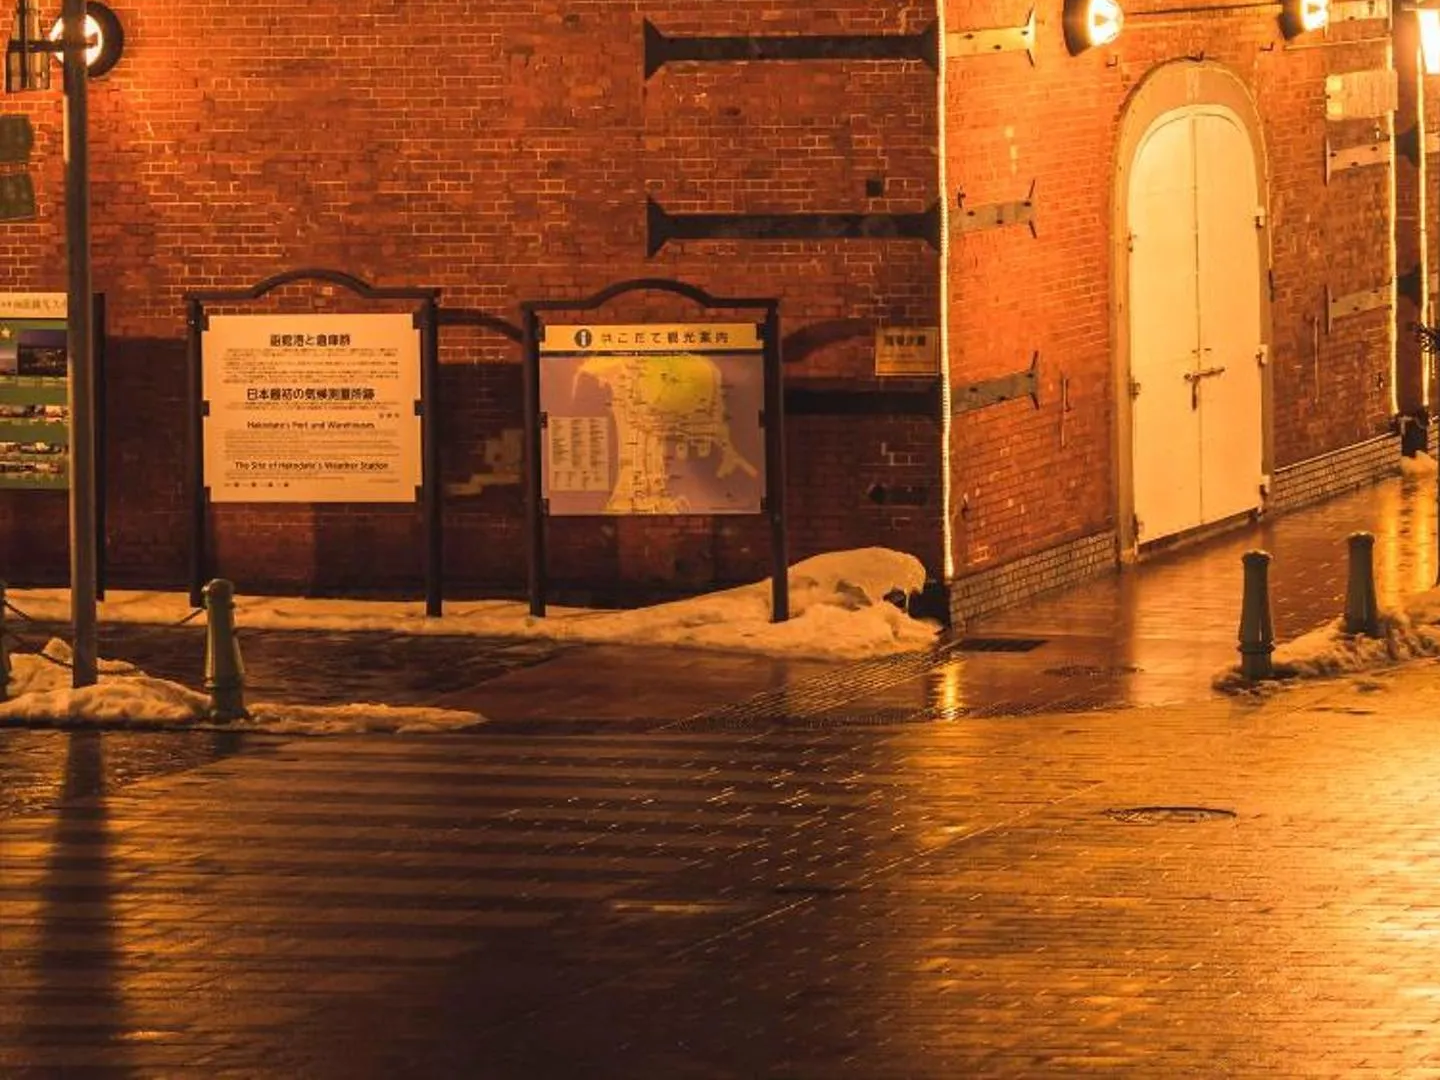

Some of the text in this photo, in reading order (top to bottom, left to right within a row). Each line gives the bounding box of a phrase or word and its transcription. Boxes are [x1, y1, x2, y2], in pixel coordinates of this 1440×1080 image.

[601, 331, 729, 345] はこだて観光案内
